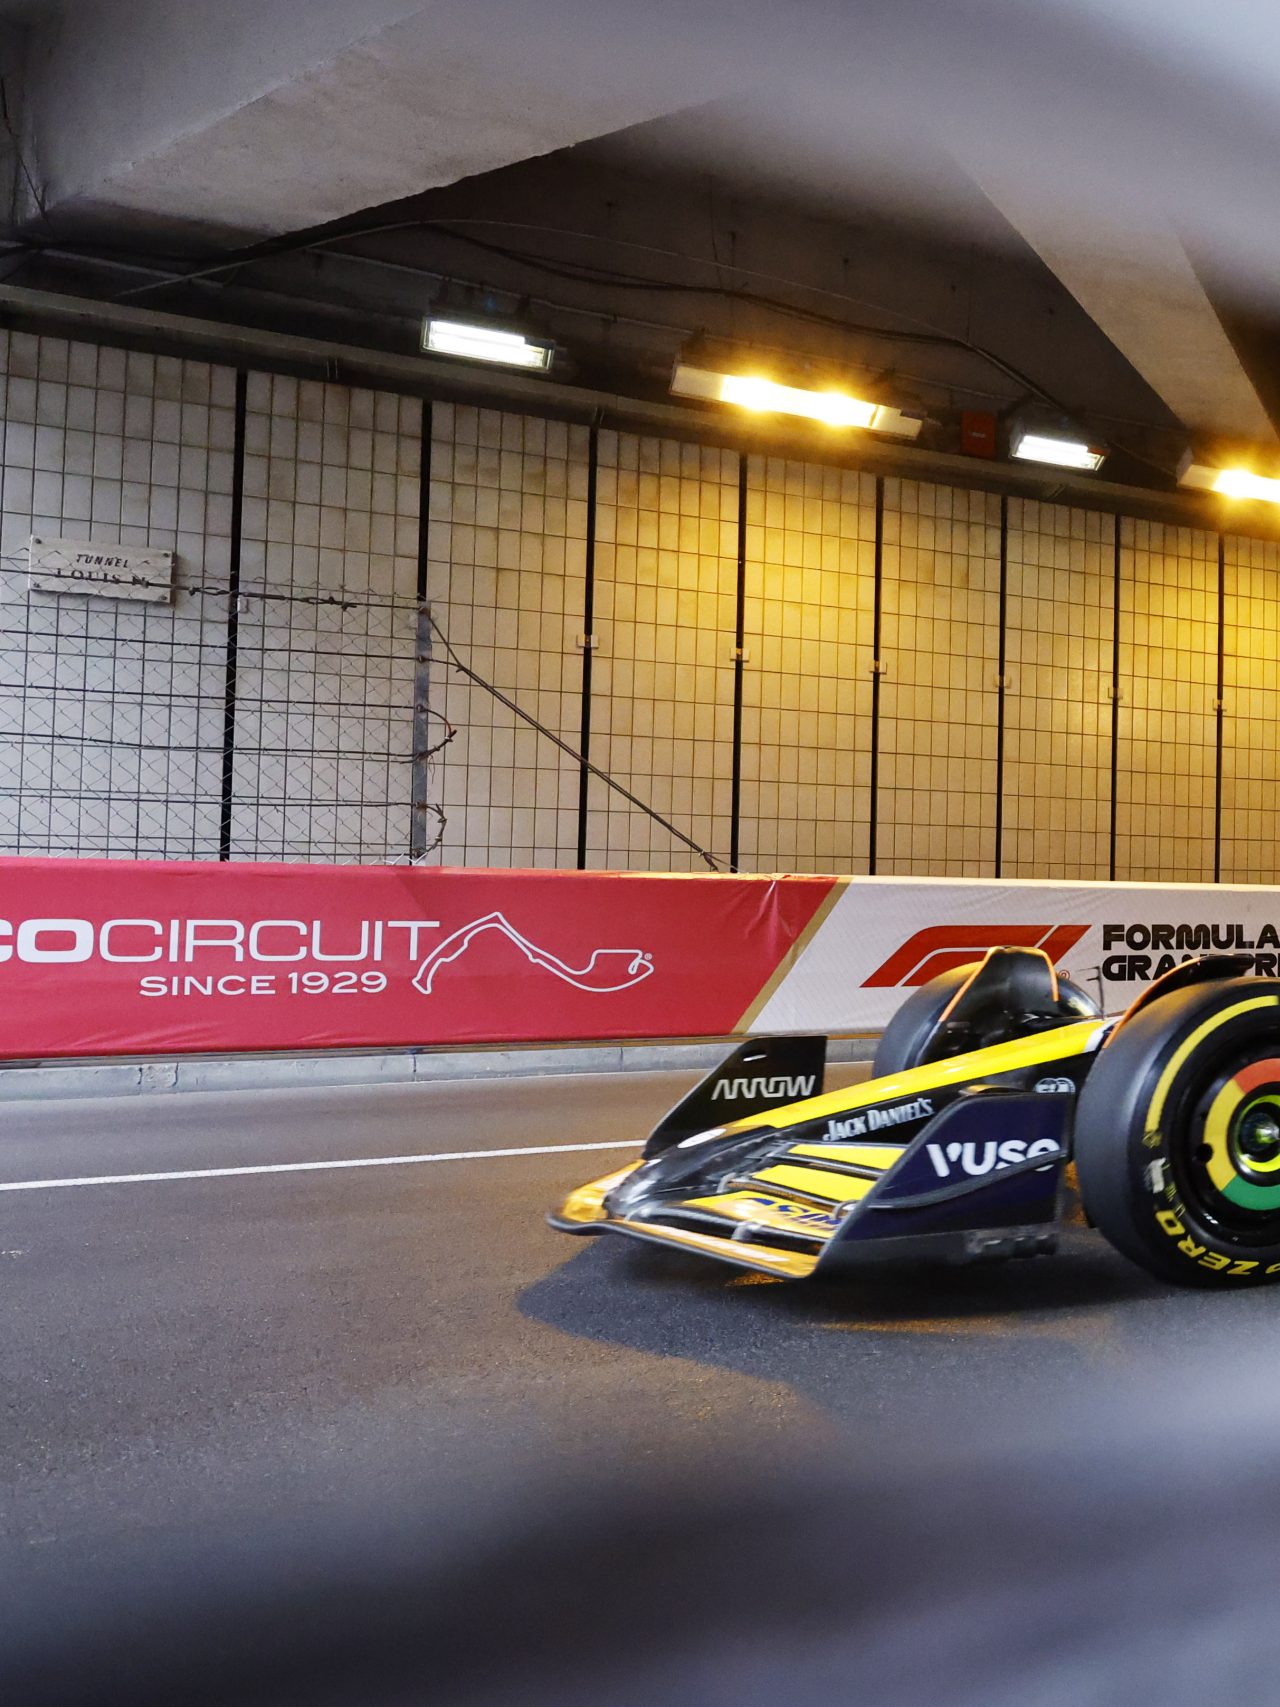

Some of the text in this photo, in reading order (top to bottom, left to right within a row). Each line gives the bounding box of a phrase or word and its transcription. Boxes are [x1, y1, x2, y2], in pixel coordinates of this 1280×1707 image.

[76, 553, 129, 568] TUNNEL
[139, 971, 387, 997] SINCE 1929
[711, 1075, 816, 1100] ARROW
[1154, 1209, 1260, 1276] ZERO
